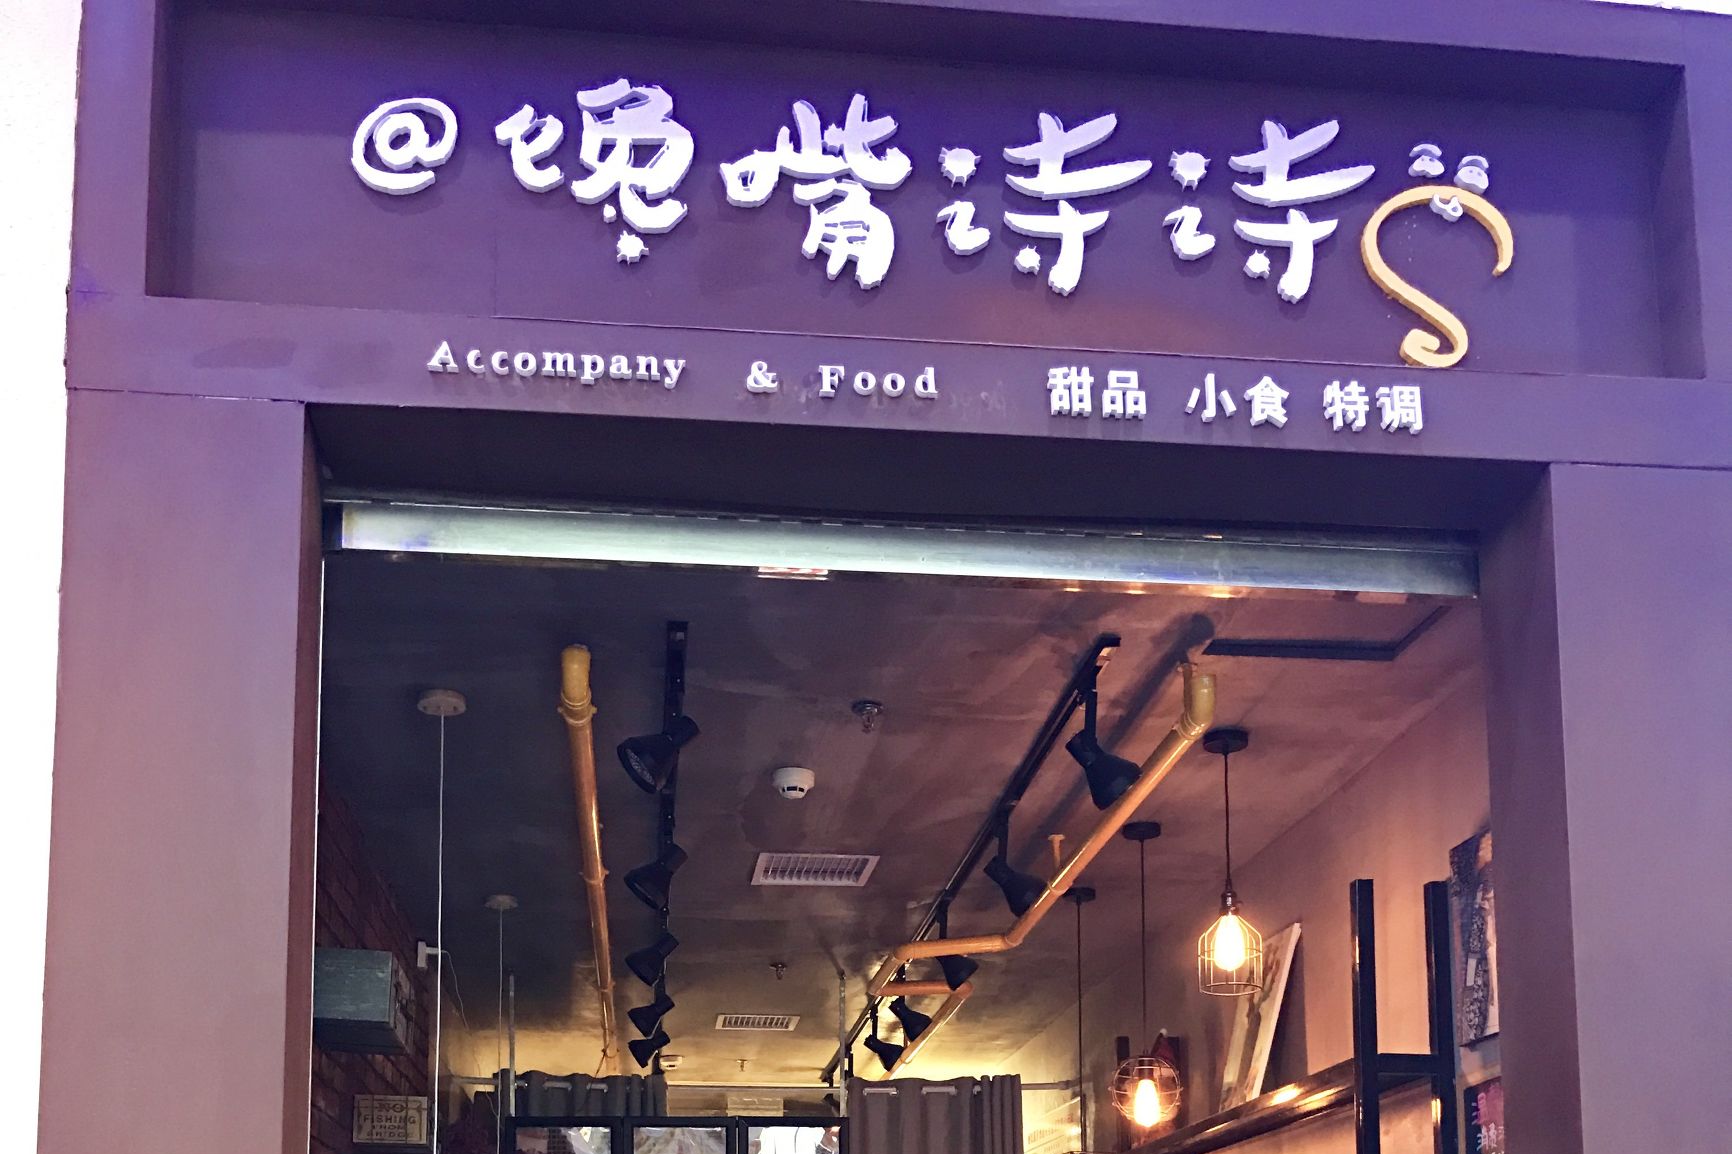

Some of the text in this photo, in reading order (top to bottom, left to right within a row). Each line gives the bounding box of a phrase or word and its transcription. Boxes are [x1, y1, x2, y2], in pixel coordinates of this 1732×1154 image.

[427, 340, 939, 399] Accompany & Food
[1046, 366, 1424, 435] 甜品 小食 特调
